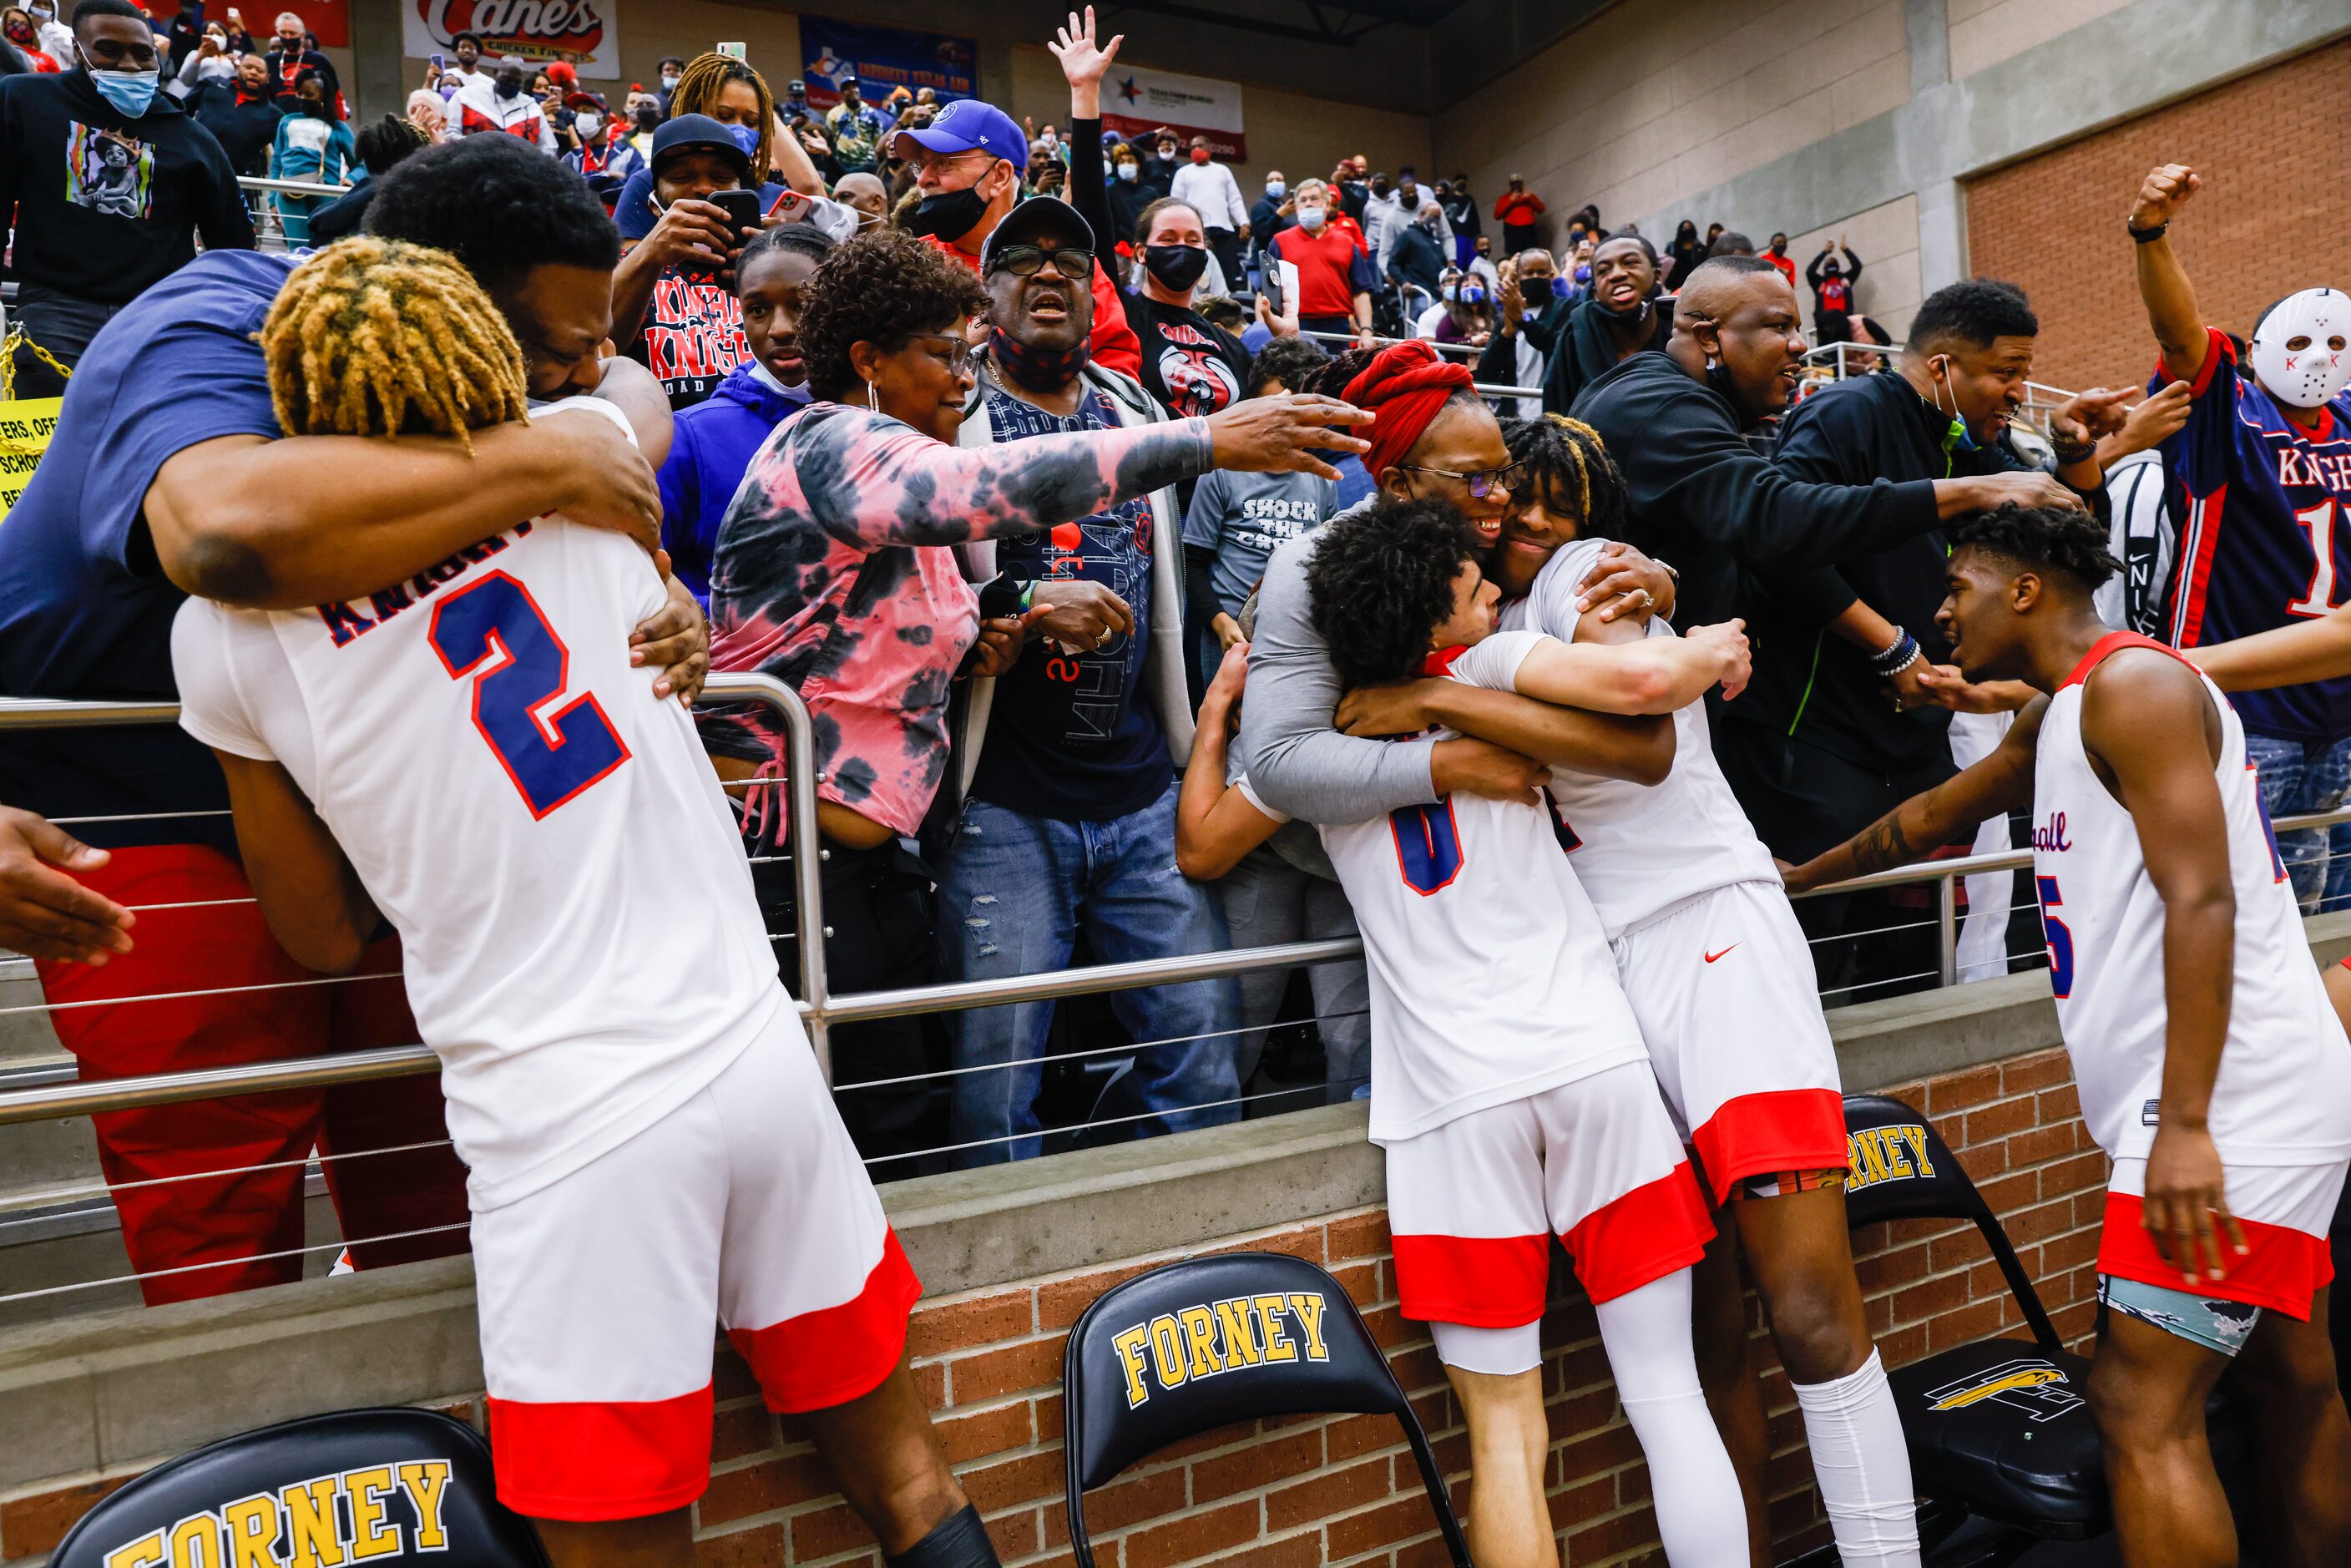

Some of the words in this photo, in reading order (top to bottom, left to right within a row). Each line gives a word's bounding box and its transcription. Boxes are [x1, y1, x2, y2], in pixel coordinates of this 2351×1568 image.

[488, 41, 535, 55] CHICKEN
[2286, 357, 2298, 371] K
[0, 420, 35, 441] ERS,
[33, 416, 58, 437] OFF
[1243, 499, 1317, 521] SHOCK
[1259, 518, 1304, 539] THE
[427, 568, 633, 822] 2
[1843, 1124, 1936, 1195] RNEY
[1111, 1292, 1330, 1410] FORNEY
